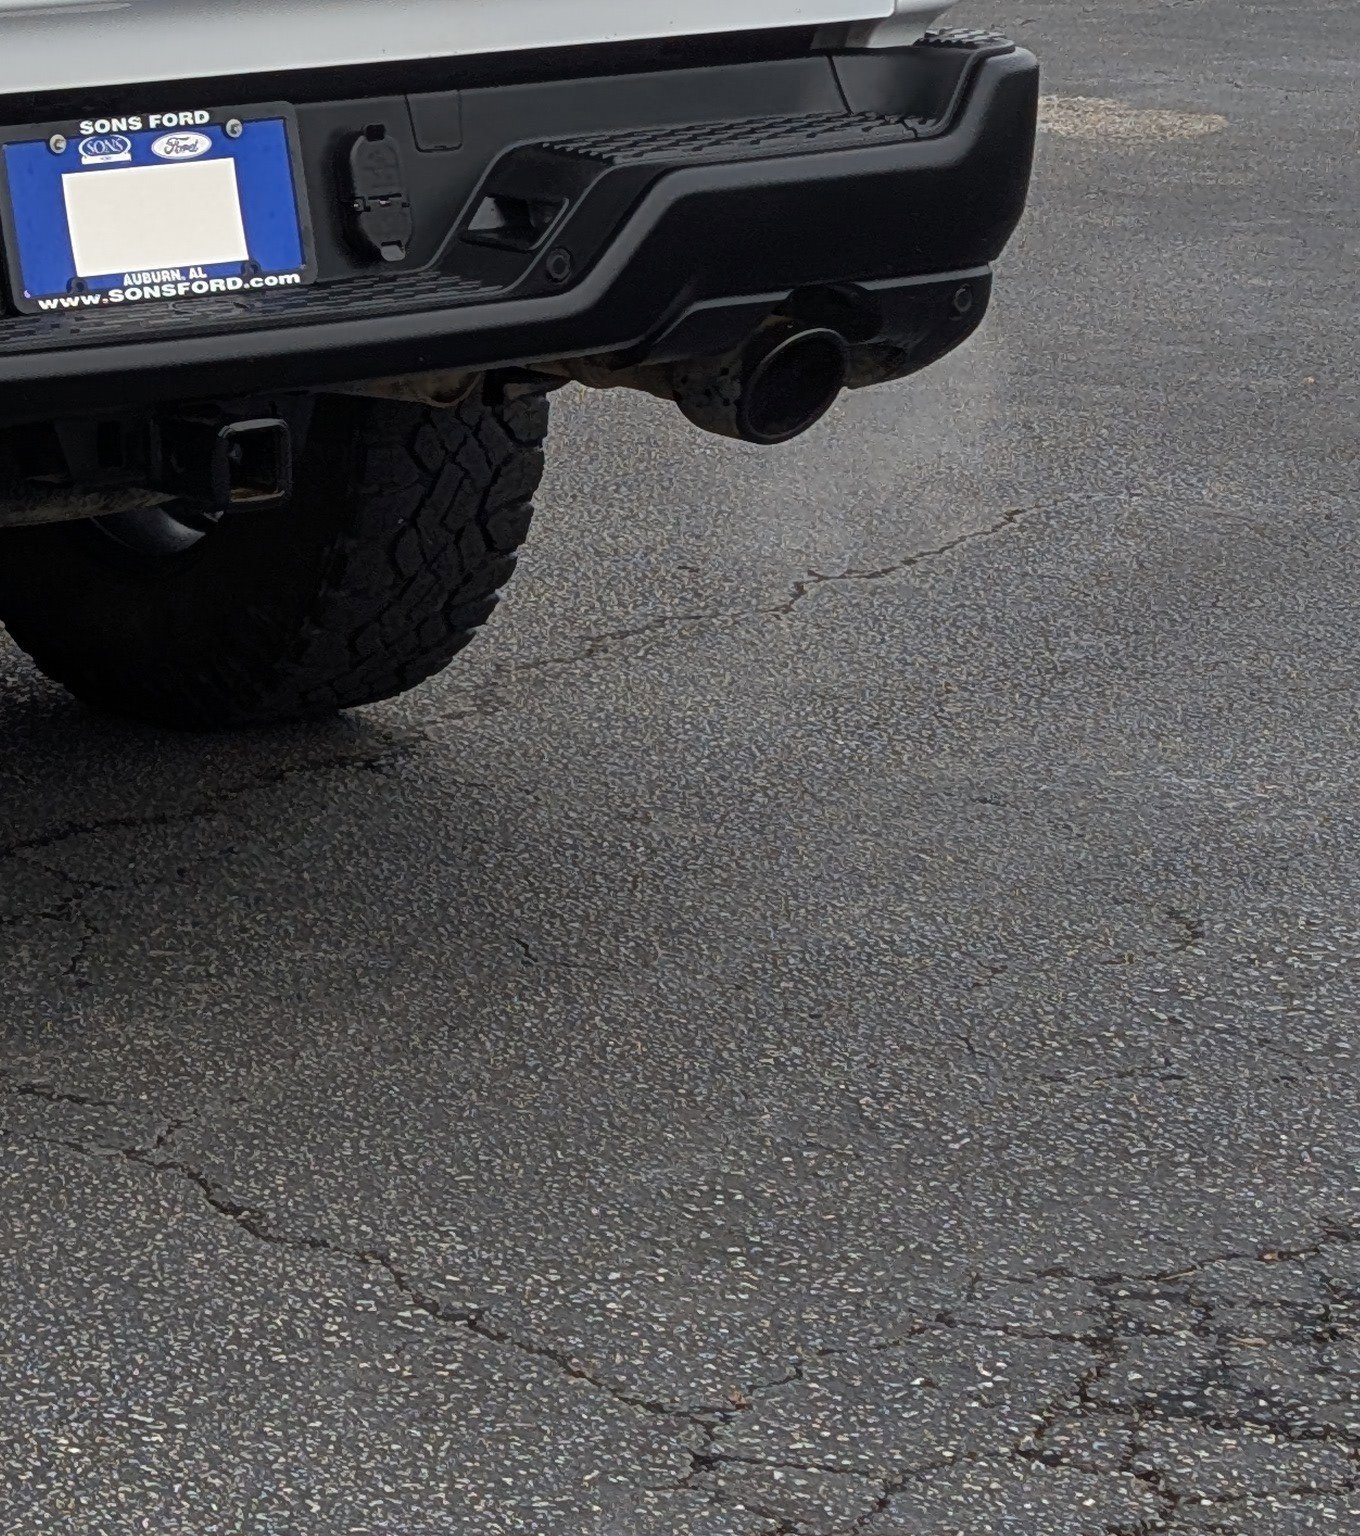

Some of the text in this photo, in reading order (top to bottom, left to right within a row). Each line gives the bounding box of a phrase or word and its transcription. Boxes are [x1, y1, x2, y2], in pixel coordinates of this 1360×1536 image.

[79, 110, 210, 136] SONS FORD
[85, 136, 125, 156] SONS
[163, 135, 200, 155] Ford
[188, 266, 208, 280] AL
[38, 272, 301, 310] www.SONSFORD.com
